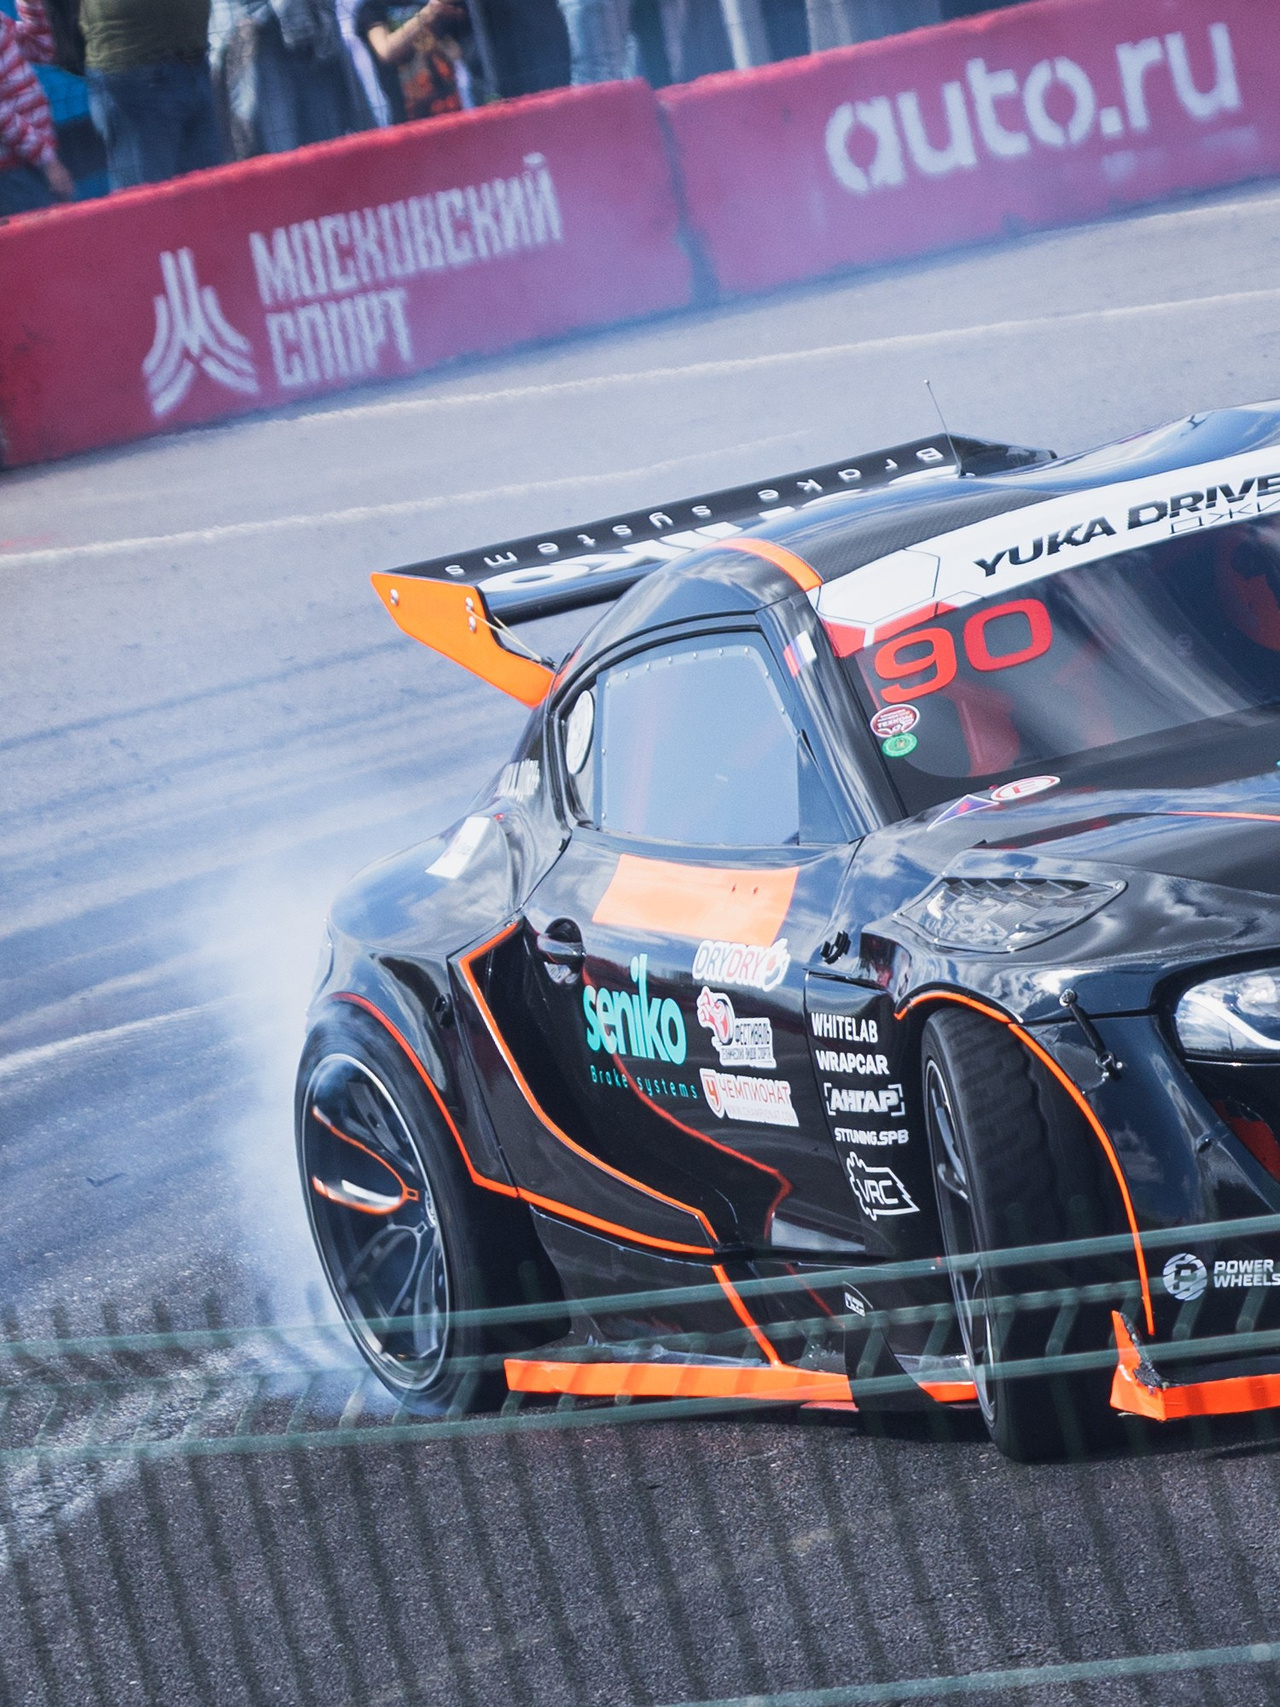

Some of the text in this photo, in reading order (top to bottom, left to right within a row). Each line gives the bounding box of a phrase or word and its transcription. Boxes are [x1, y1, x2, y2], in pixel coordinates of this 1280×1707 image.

[825, 22, 1241, 194] auto.ru
[249, 151, 564, 306] МОСКОВСКИЙ
[266, 288, 415, 389] СПОРТ
[973, 516, 1118, 578] YUKA
[873, 598, 1053, 704] 90
[583, 953, 687, 1065] seniko
[811, 1012, 878, 1044] WHITELAB
[816, 1050, 890, 1075] WRAPCAR
[590, 1065, 698, 1099] Brake systems
[720, 1080, 788, 1105] ЧЕМПИОНАТ
[830, 1088, 900, 1113] АНГАР
[856, 1178, 899, 1205] VRC
[1213, 1259, 1274, 1274] POWER
